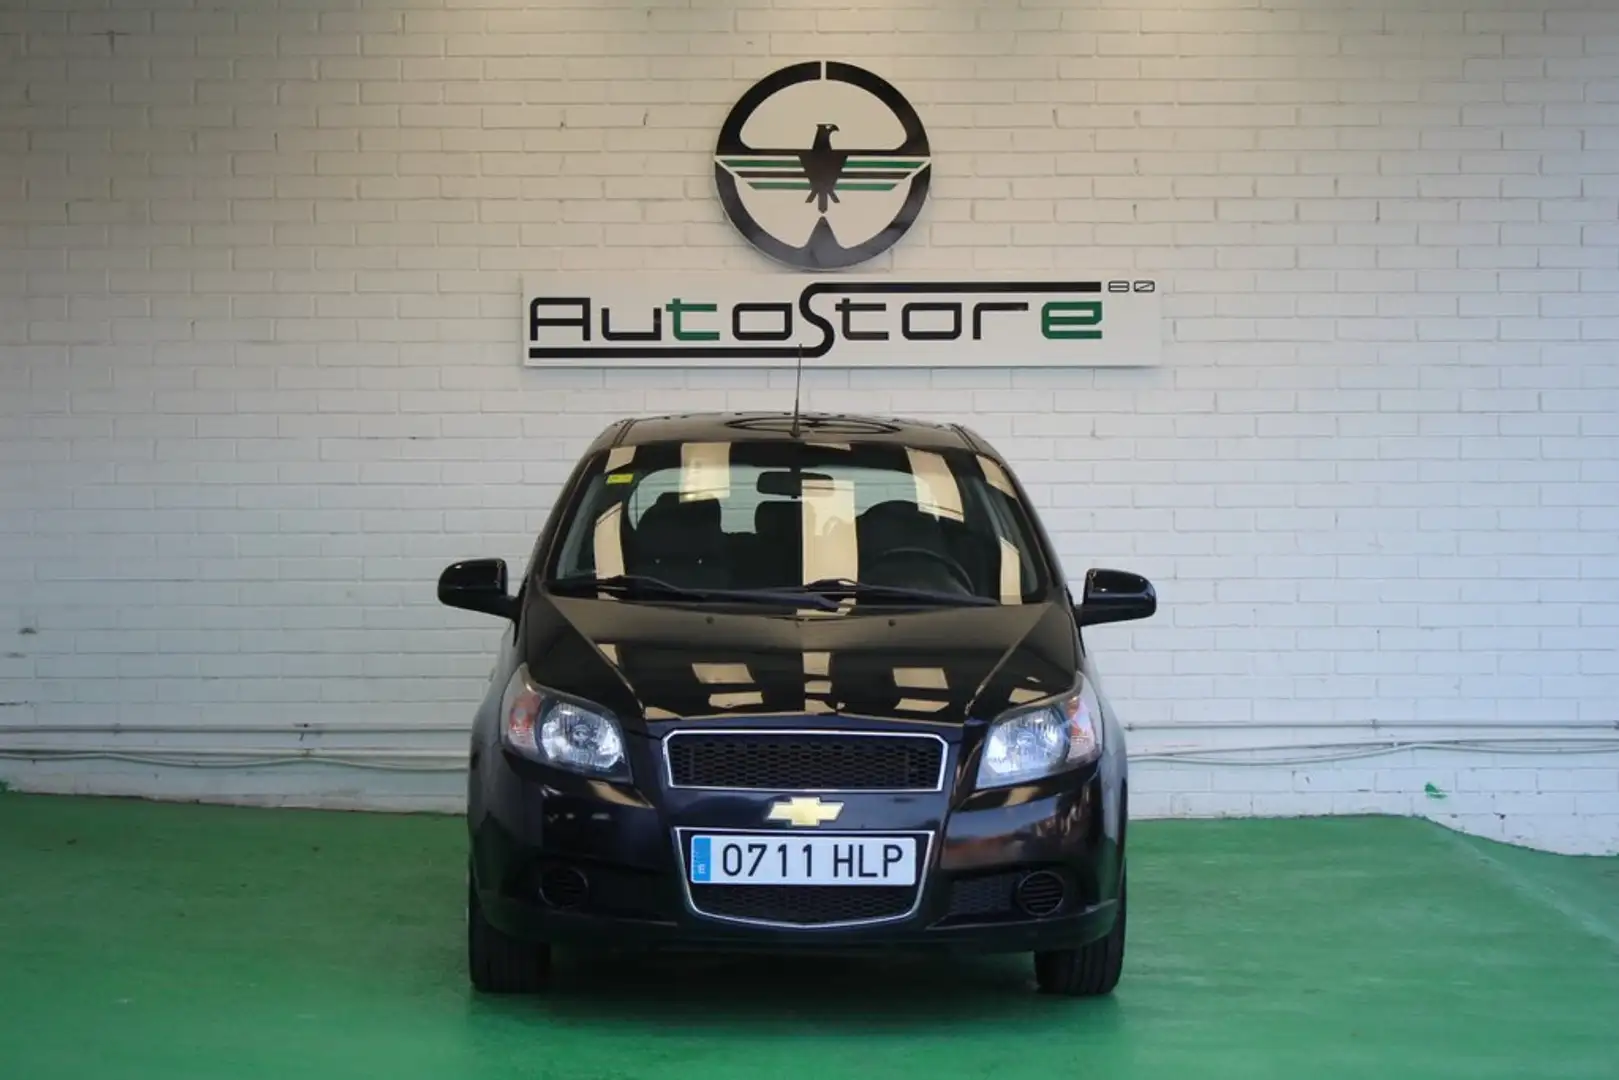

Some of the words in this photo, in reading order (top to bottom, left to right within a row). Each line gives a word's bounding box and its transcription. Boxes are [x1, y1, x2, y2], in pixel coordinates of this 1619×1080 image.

[529, 281, 1102, 359] AutoStore
[722, 843, 813, 877] 0711
[832, 844, 903, 878] HLP
